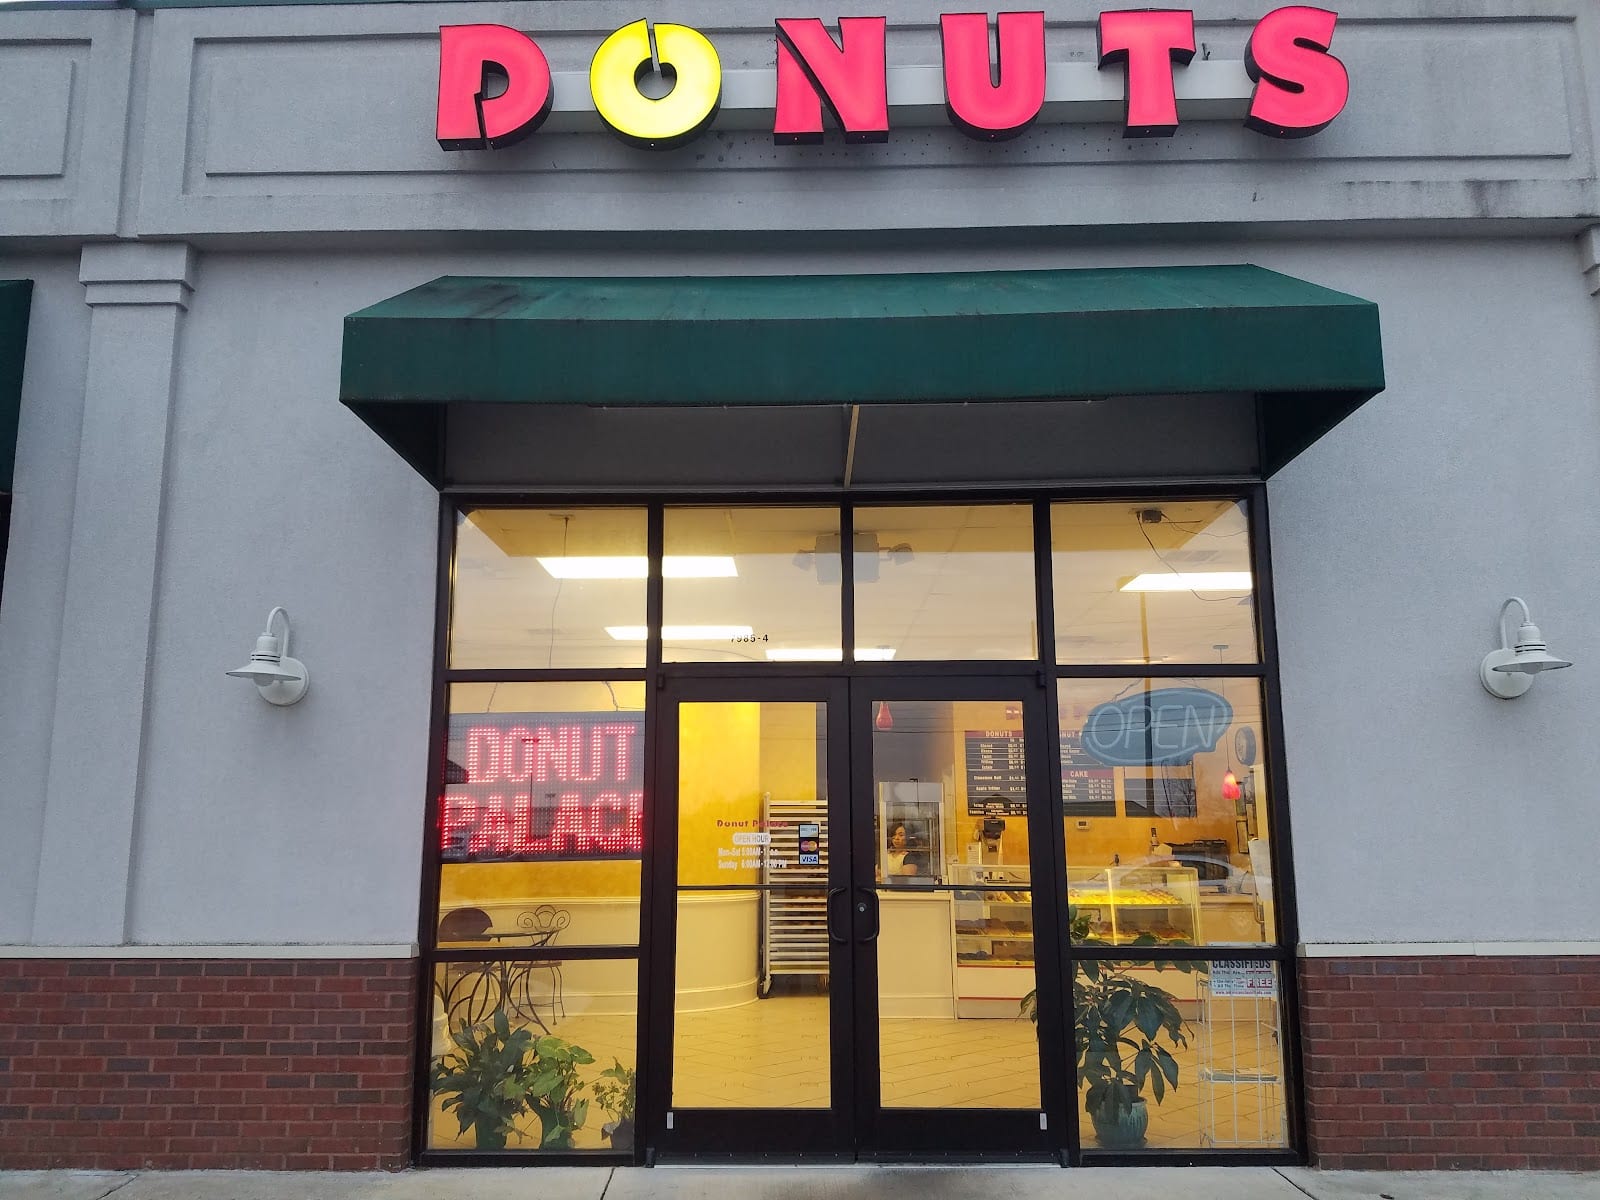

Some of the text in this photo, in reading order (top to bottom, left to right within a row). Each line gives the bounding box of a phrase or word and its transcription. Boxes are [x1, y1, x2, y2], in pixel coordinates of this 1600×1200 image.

[436, 5, 1350, 150] DONUTS
[1091, 704, 1217, 749] OPEN
[467, 725, 637, 784] DONUT
[1070, 770, 1088, 778] CAKE
[716, 820, 749, 828] Donut
[1212, 960, 1271, 969] CLASSIFIEDS
[1247, 978, 1273, 987] FREE
